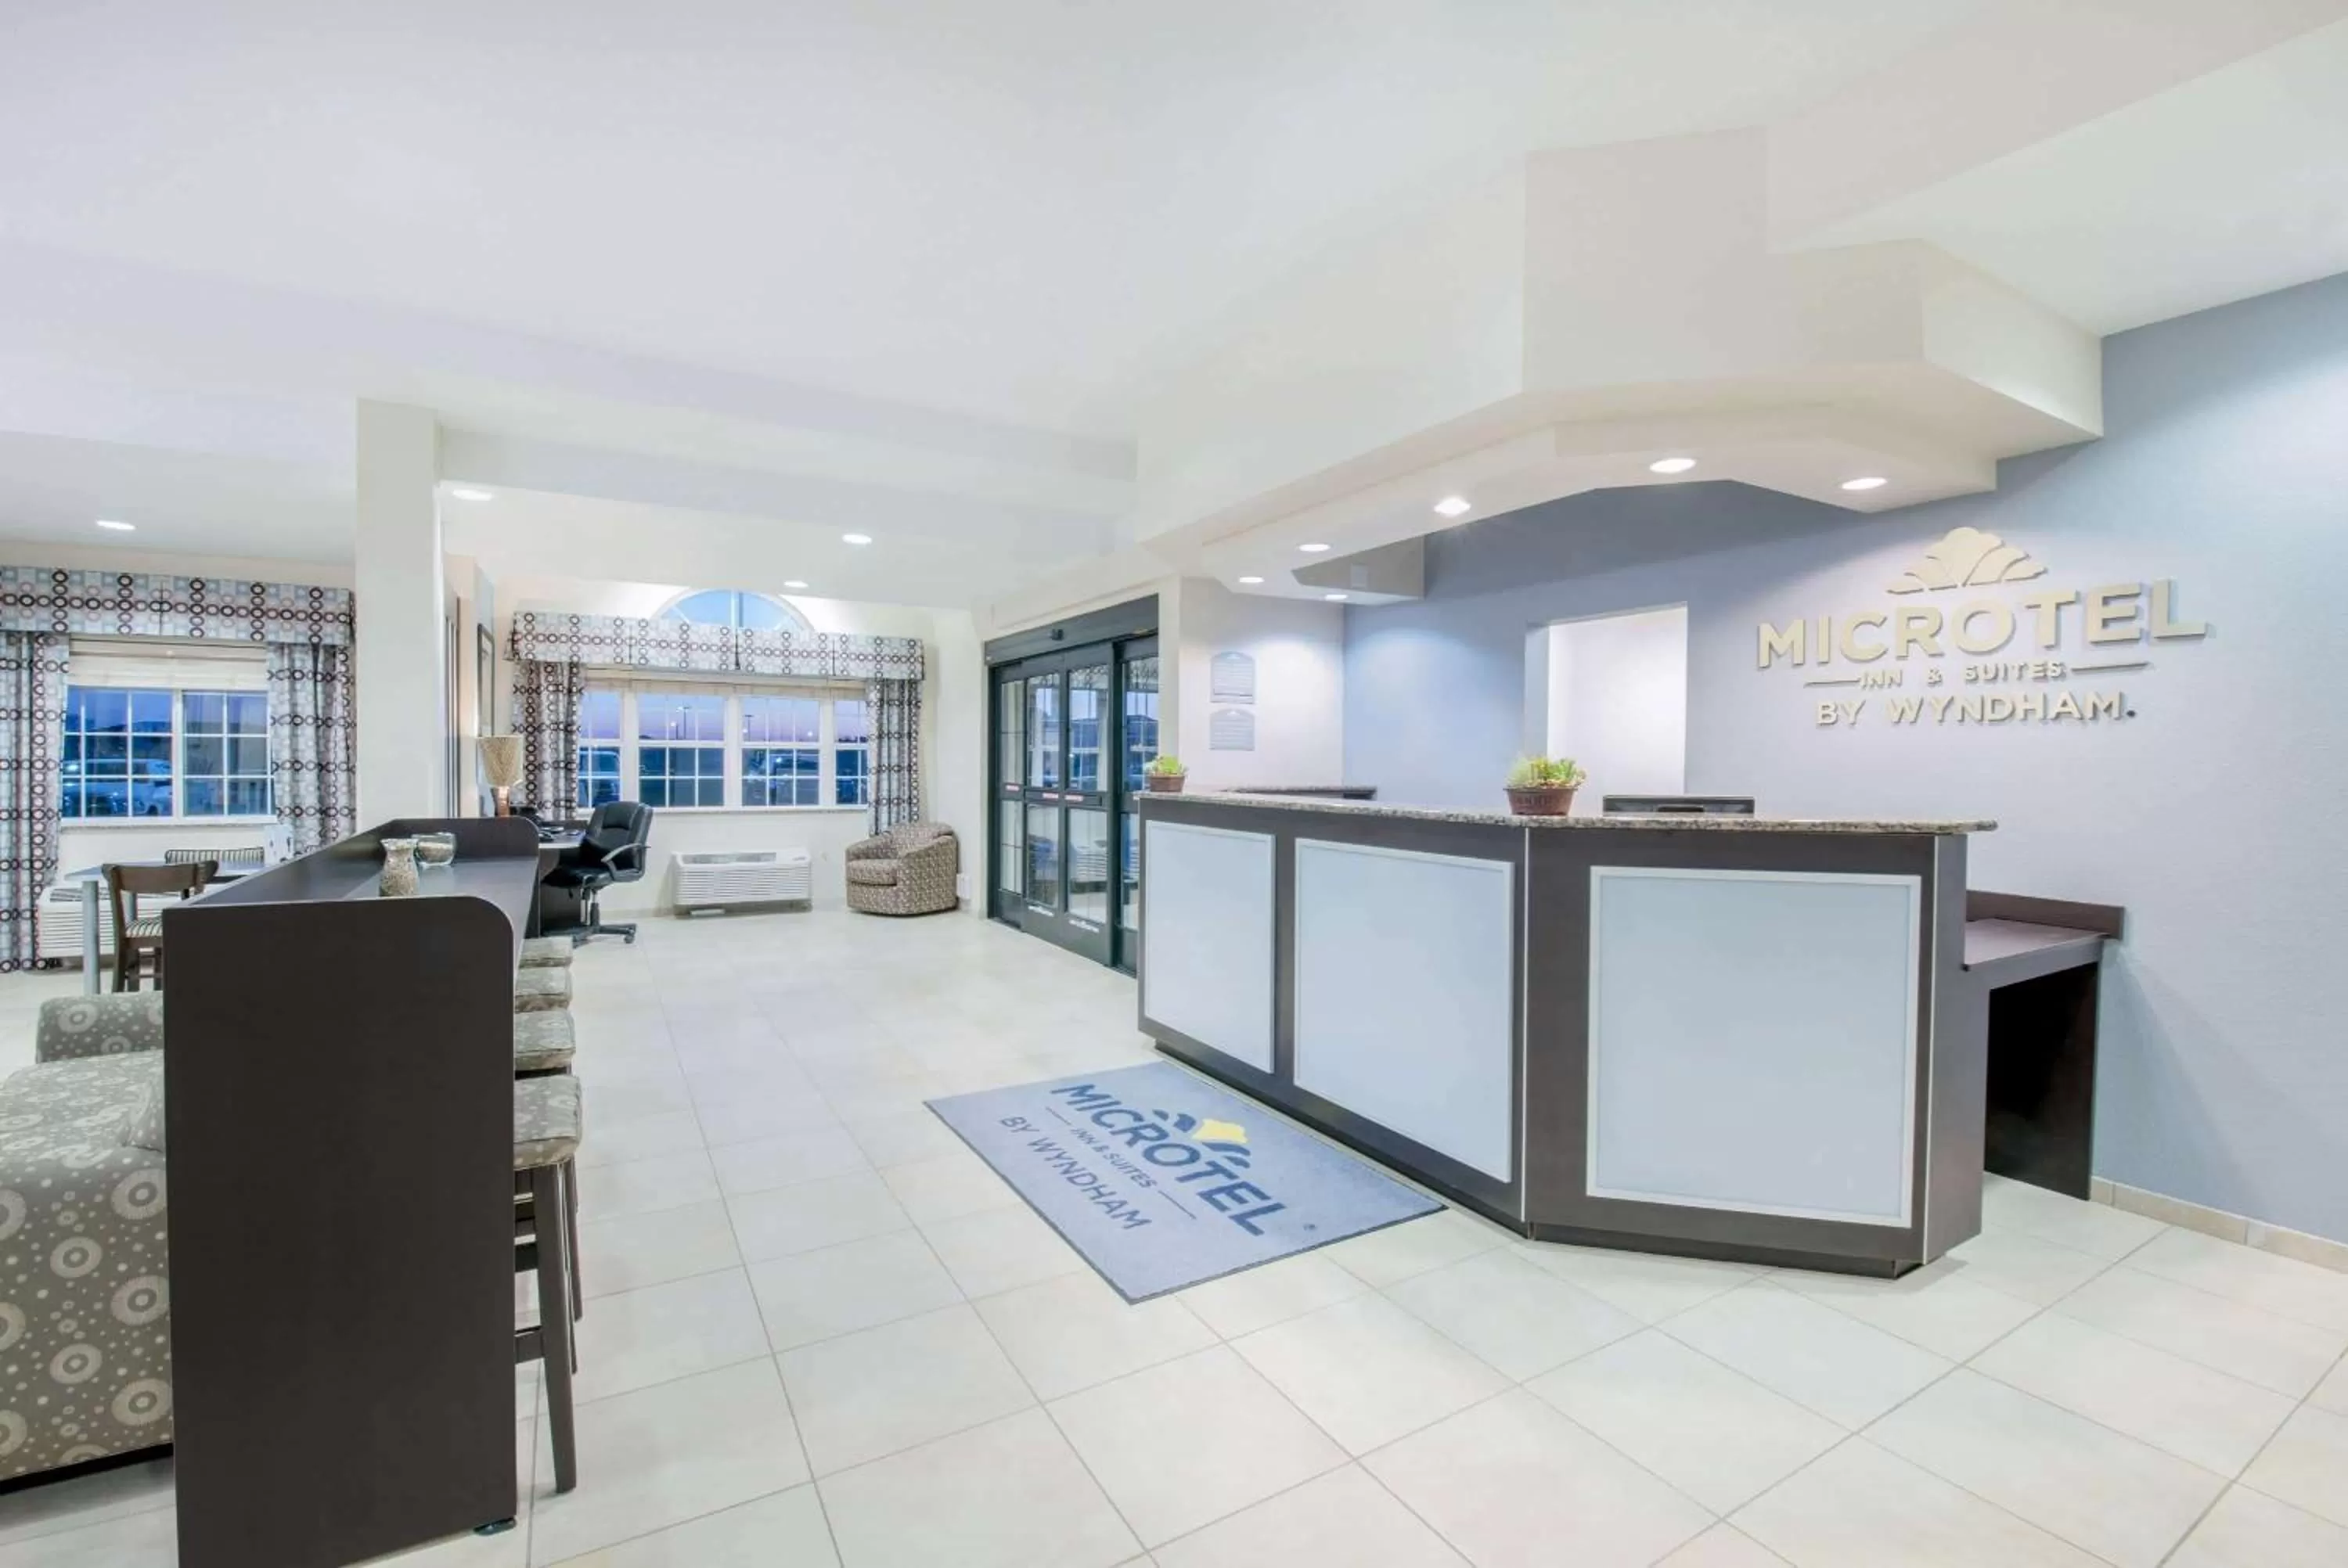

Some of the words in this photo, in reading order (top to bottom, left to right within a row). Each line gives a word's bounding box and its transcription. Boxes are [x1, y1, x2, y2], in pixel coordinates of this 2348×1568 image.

[1756, 577, 2210, 668] MICROTEL
[1816, 699, 1867, 726] BY
[1859, 670, 1903, 689] INN
[1927, 666, 1943, 687] &
[1964, 660, 2068, 685] SUITES
[999, 1116, 1040, 1133] BY
[1026, 1136, 1153, 1230] WYNDHAM
[1050, 1083, 1288, 1237] MICROTEL
[1070, 1127, 1097, 1145] INN
[1103, 1152, 1158, 1189] SUITES
